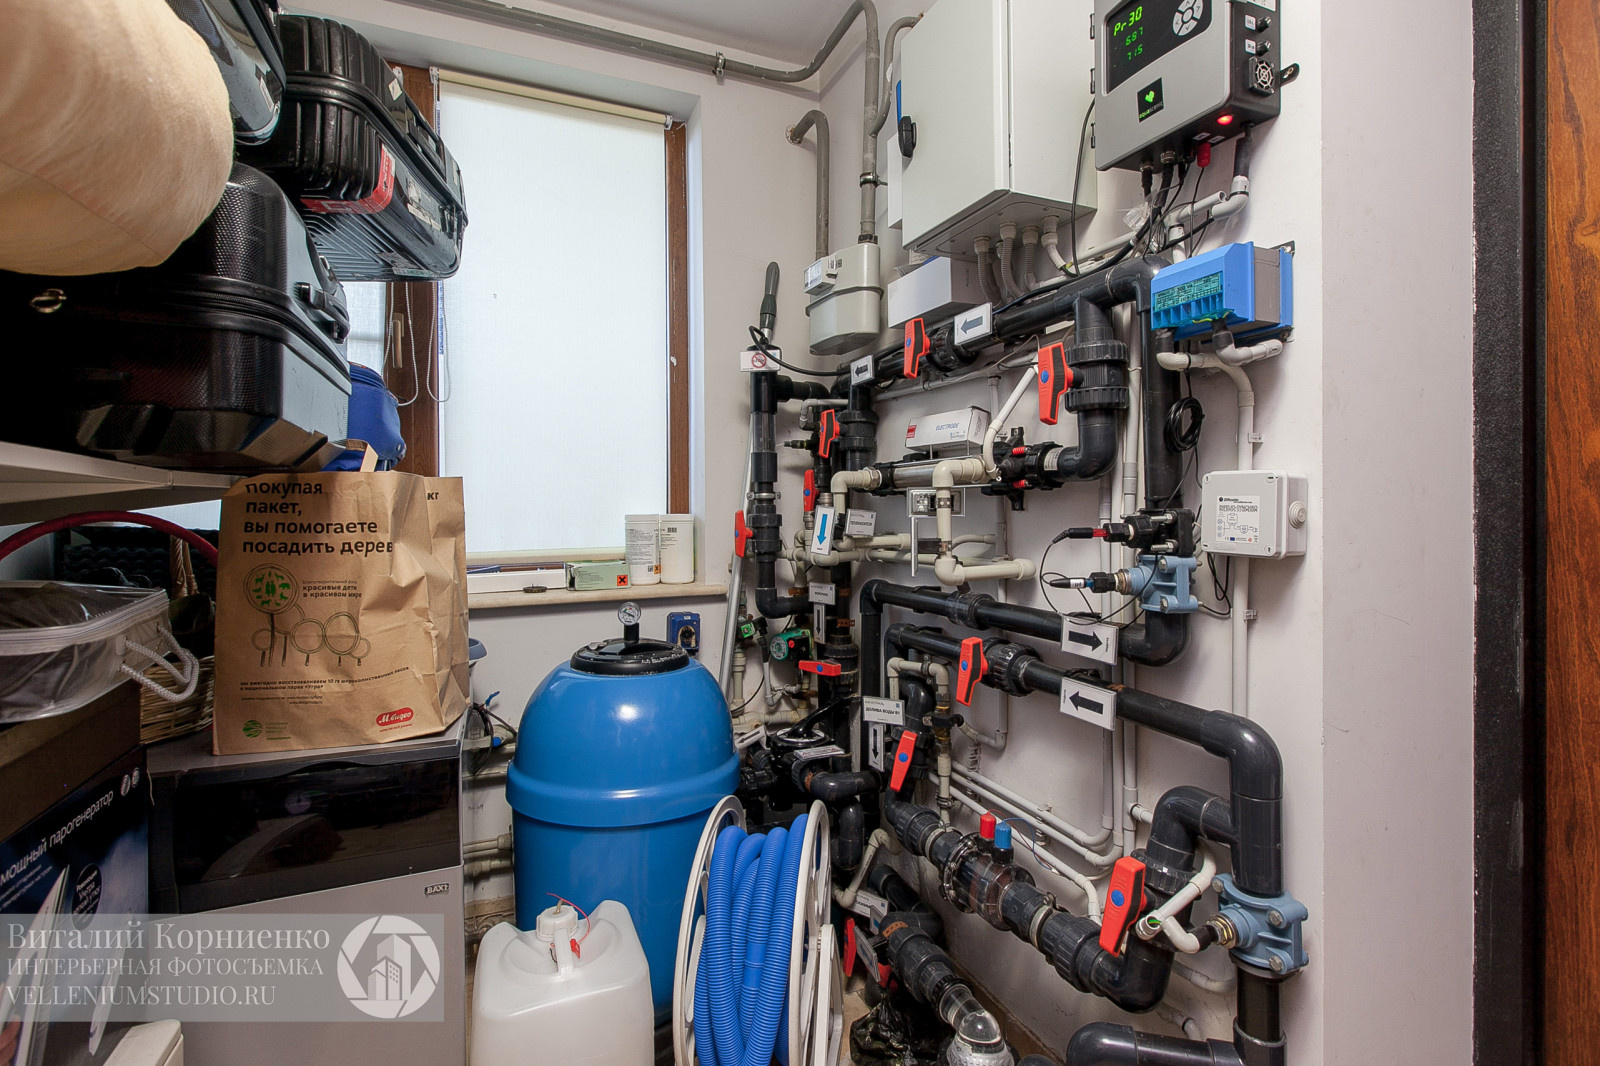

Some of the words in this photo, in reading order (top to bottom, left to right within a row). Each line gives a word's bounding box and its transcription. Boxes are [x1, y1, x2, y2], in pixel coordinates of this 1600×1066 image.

[935, 422, 960, 431] ELECTRODE
[245, 482, 322, 499] покупая
[246, 501, 302, 516] пакет,
[243, 521, 269, 533] вы
[274, 521, 378, 534] помогаете
[242, 541, 335, 556] посадить
[310, 591, 346, 599] красивом
[0, 837, 47, 887] мощный
[49, 790, 114, 848] парогенератор
